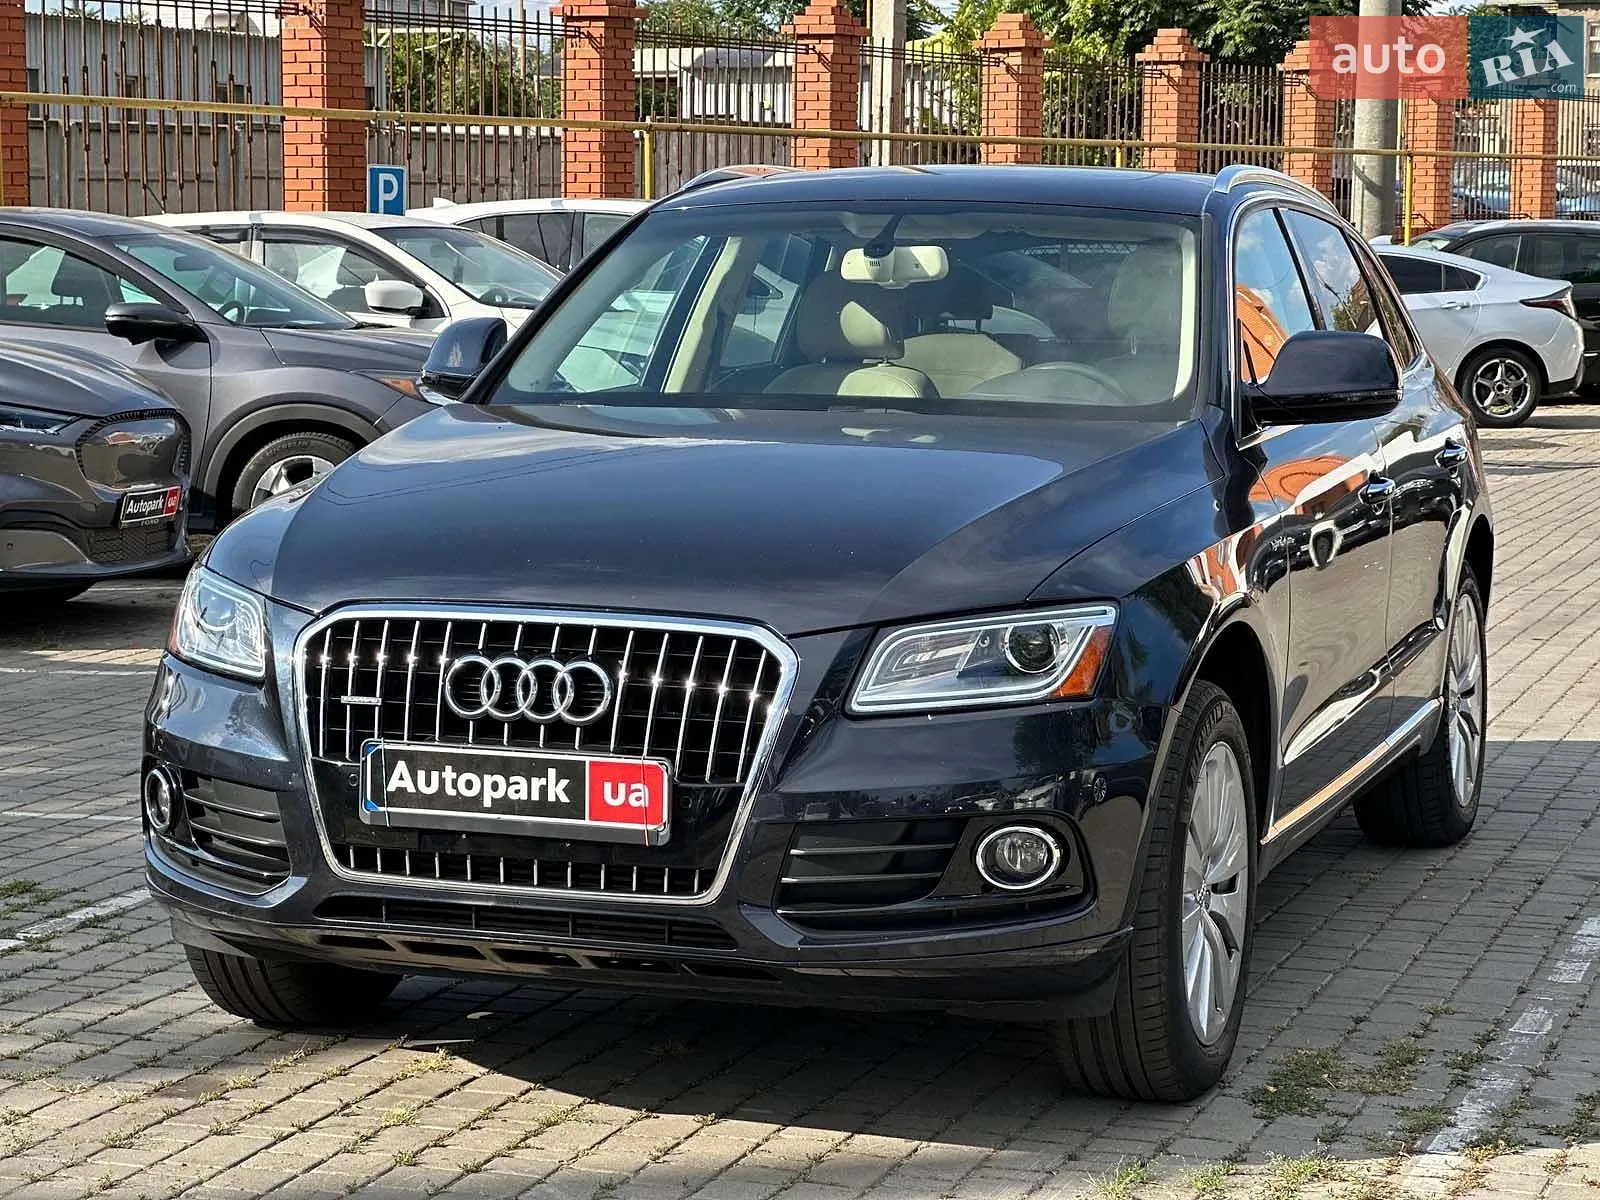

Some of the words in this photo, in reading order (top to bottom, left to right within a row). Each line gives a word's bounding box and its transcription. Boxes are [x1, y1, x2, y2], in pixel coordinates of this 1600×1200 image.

[378, 172, 399, 215] P
[126, 495, 164, 516] Autopark
[386, 759, 571, 809] Autopark
[603, 779, 650, 808] ua
